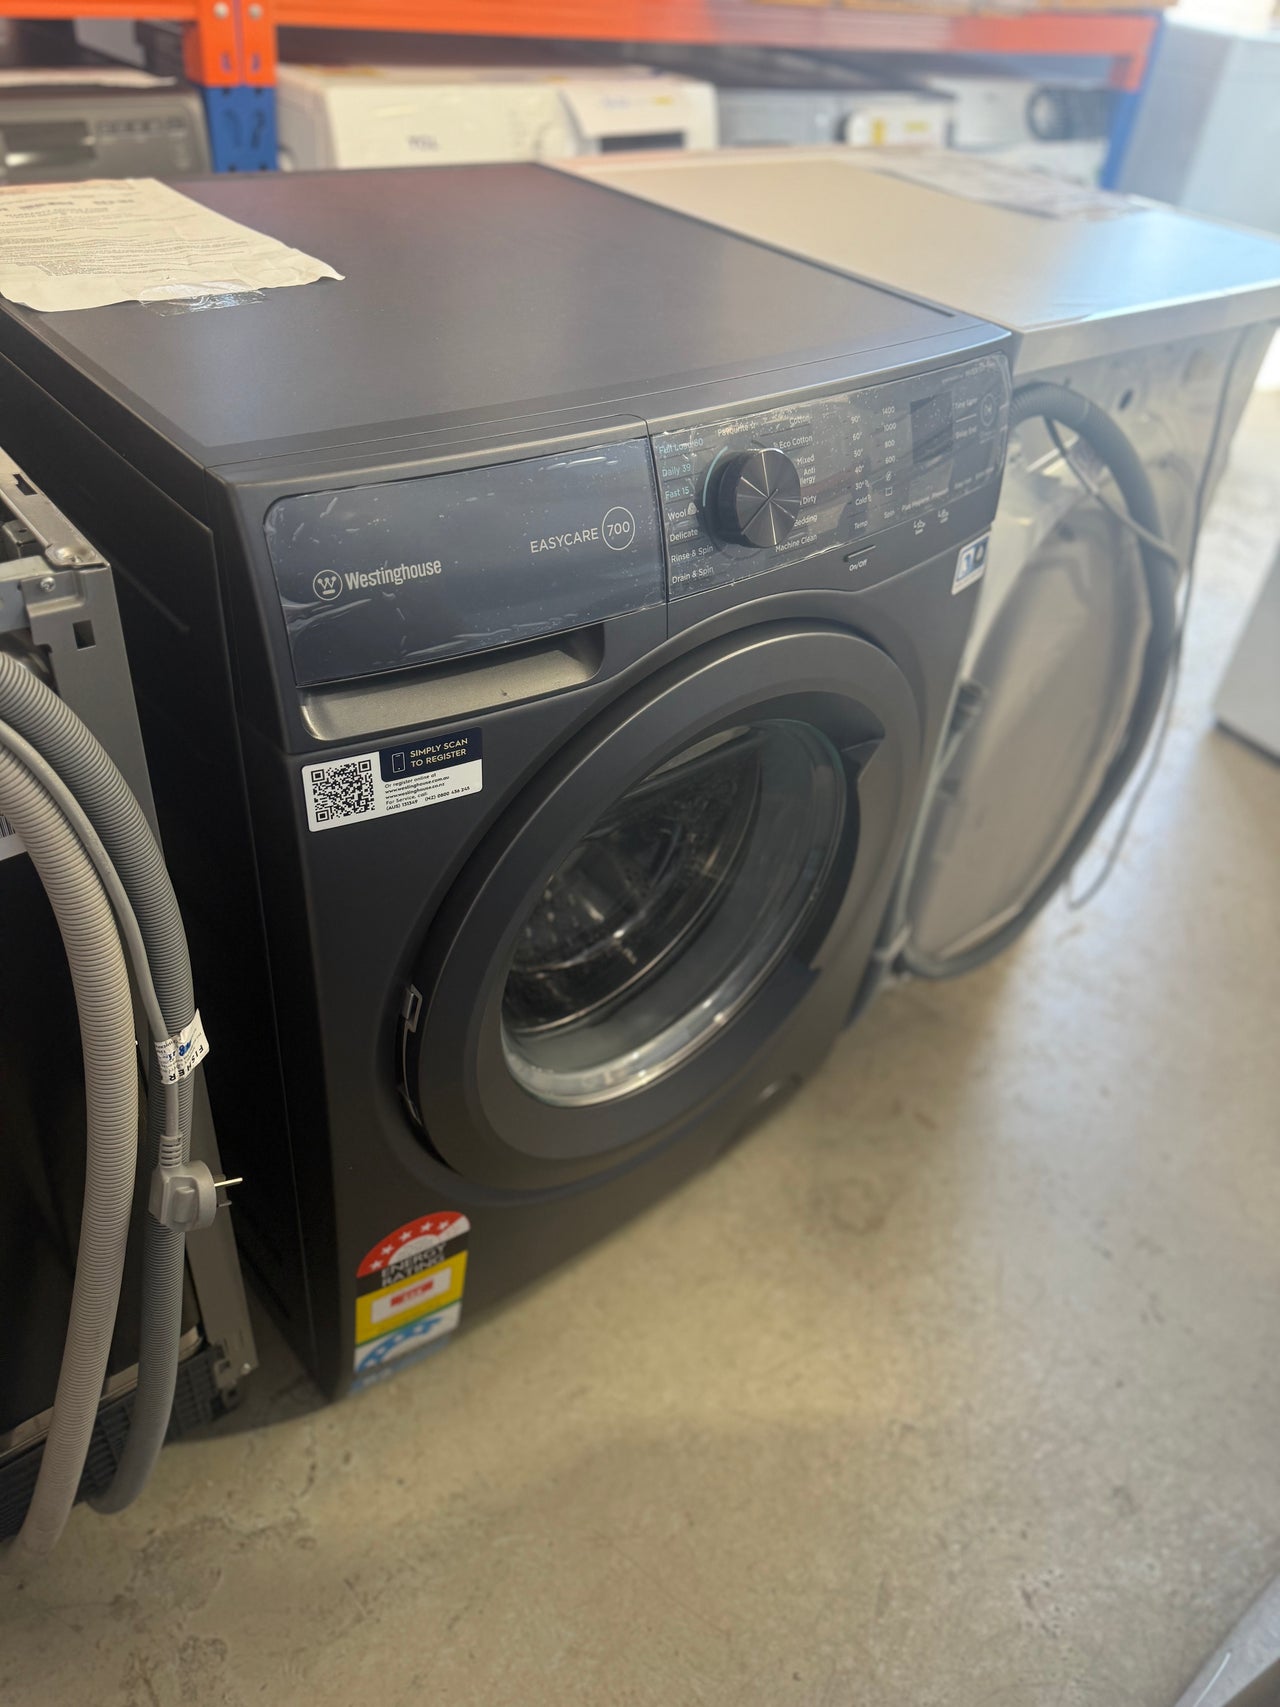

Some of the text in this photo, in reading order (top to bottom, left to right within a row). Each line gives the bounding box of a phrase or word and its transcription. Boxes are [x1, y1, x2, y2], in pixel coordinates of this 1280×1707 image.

[882, 406, 895, 415] 1400
[789, 414, 810, 427] Cotton
[883, 422, 897, 432] 1000
[779, 435, 813, 450] Eco Cotton
[662, 464, 691, 478] Daily 39
[803, 468, 816, 476] Anti
[665, 487, 690, 500] Fast 15
[802, 495, 817, 504] Dirty
[855, 495, 867, 506] Cold
[667, 509, 687, 521] Wool
[883, 510, 896, 520] Spin
[854, 520, 869, 530] Temp
[530, 521, 630, 554] EASYCARE 700
[669, 528, 699, 542] Delicate
[775, 534, 818, 553] Machine Clean
[671, 544, 714, 564] Rinse & Spin
[849, 558, 868, 572] On/Off
[345, 560, 442, 591] Westinghouse
[672, 566, 714, 584] Drain & Spin
[410, 738, 468, 758] SIMPLY SCAN
[411, 748, 467, 768] TO REGISTER
[393, 778, 413, 788] register
[168, 1044, 204, 1082] FISHER
